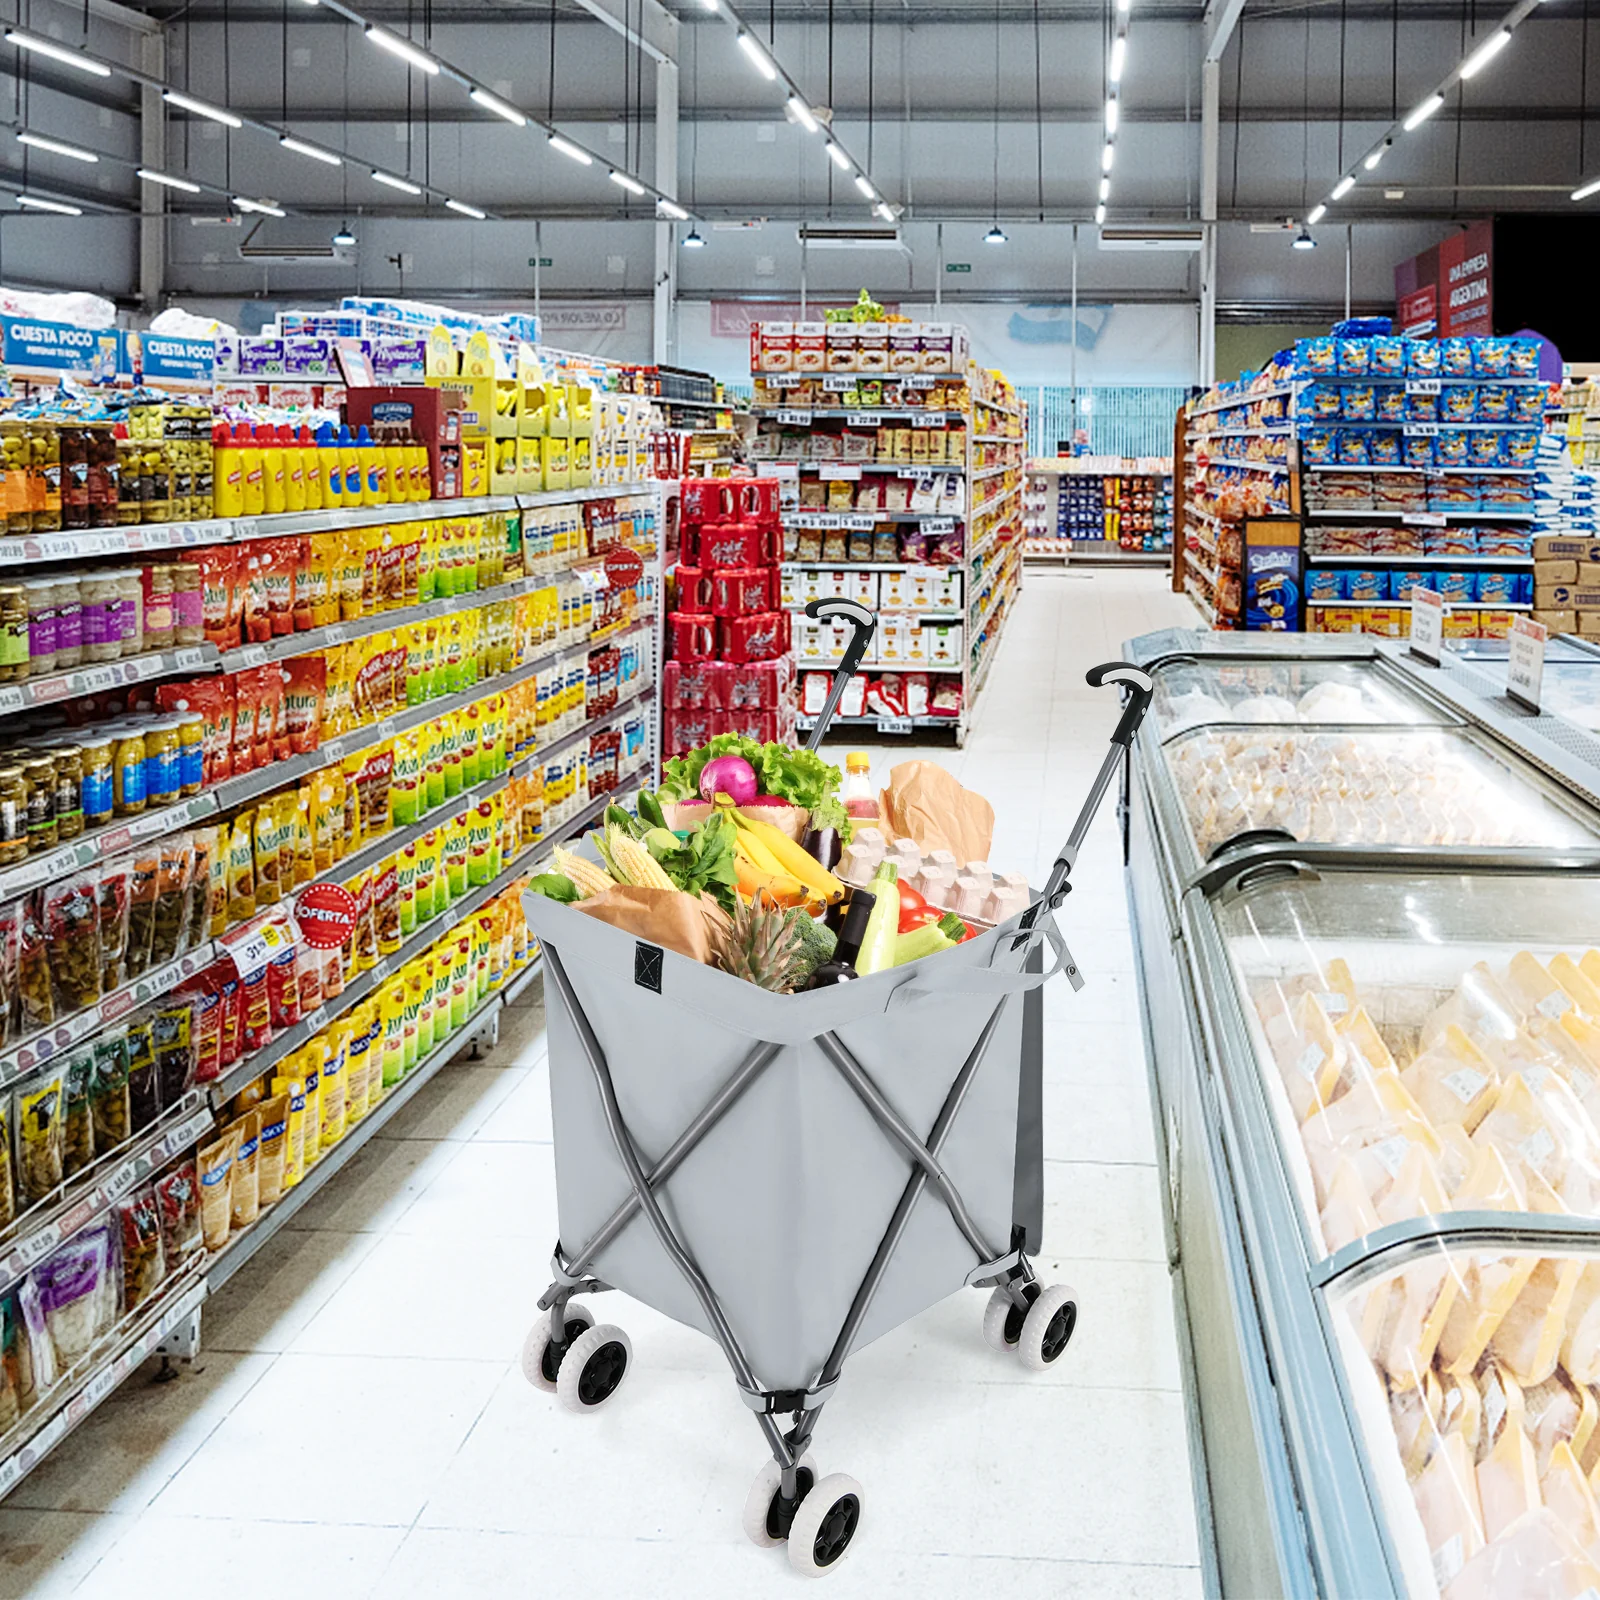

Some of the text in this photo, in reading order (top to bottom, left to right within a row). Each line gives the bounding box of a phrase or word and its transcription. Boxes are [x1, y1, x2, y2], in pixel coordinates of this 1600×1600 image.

[1449, 278, 1488, 308] ARGENTINA
[10, 324, 93, 347] CUESTA POCO
[148, 340, 214, 360] CUESTA POCO
[300, 906, 350, 925] OFERTA
